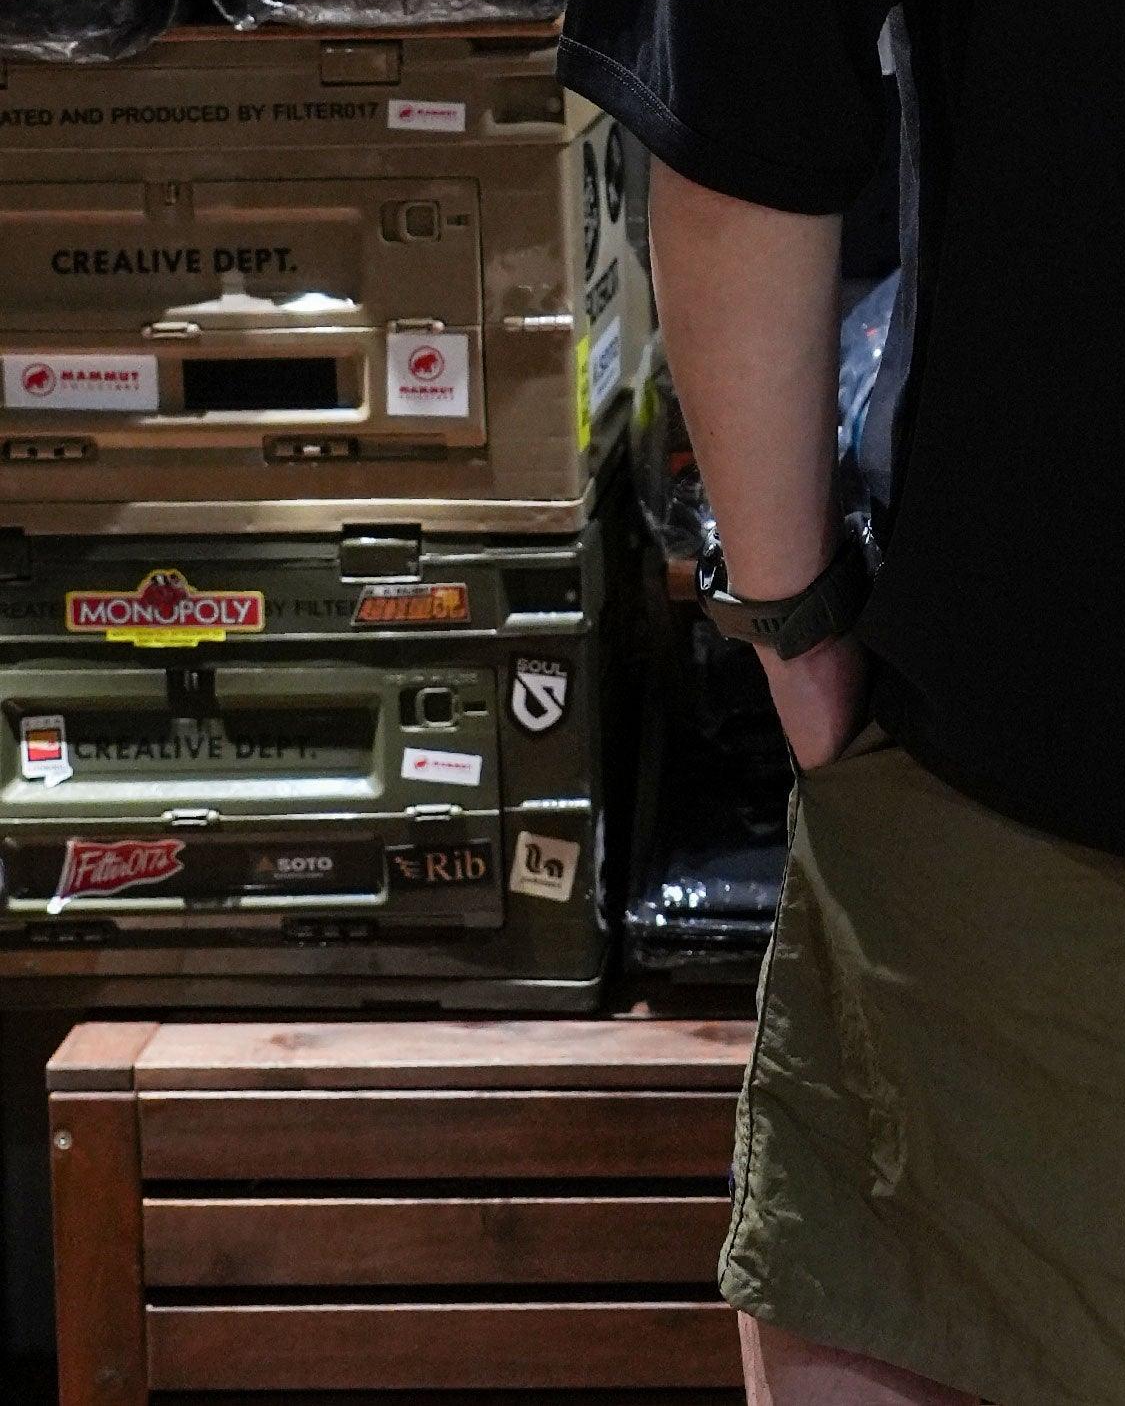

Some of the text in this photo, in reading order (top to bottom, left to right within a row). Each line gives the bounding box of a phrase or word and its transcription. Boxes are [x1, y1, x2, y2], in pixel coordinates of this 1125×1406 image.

[60, 107, 103, 124] AND
[111, 104, 230, 124] PRODUCED
[239, 105, 265, 122] BY
[273, 101, 379, 121] FILTER017
[51, 247, 298, 275] CREALIVE DEPT.
[61, 370, 139, 381] MAMMUT
[79, 599, 250, 624] MONOPOLY
[427, 850, 487, 882] Rib
